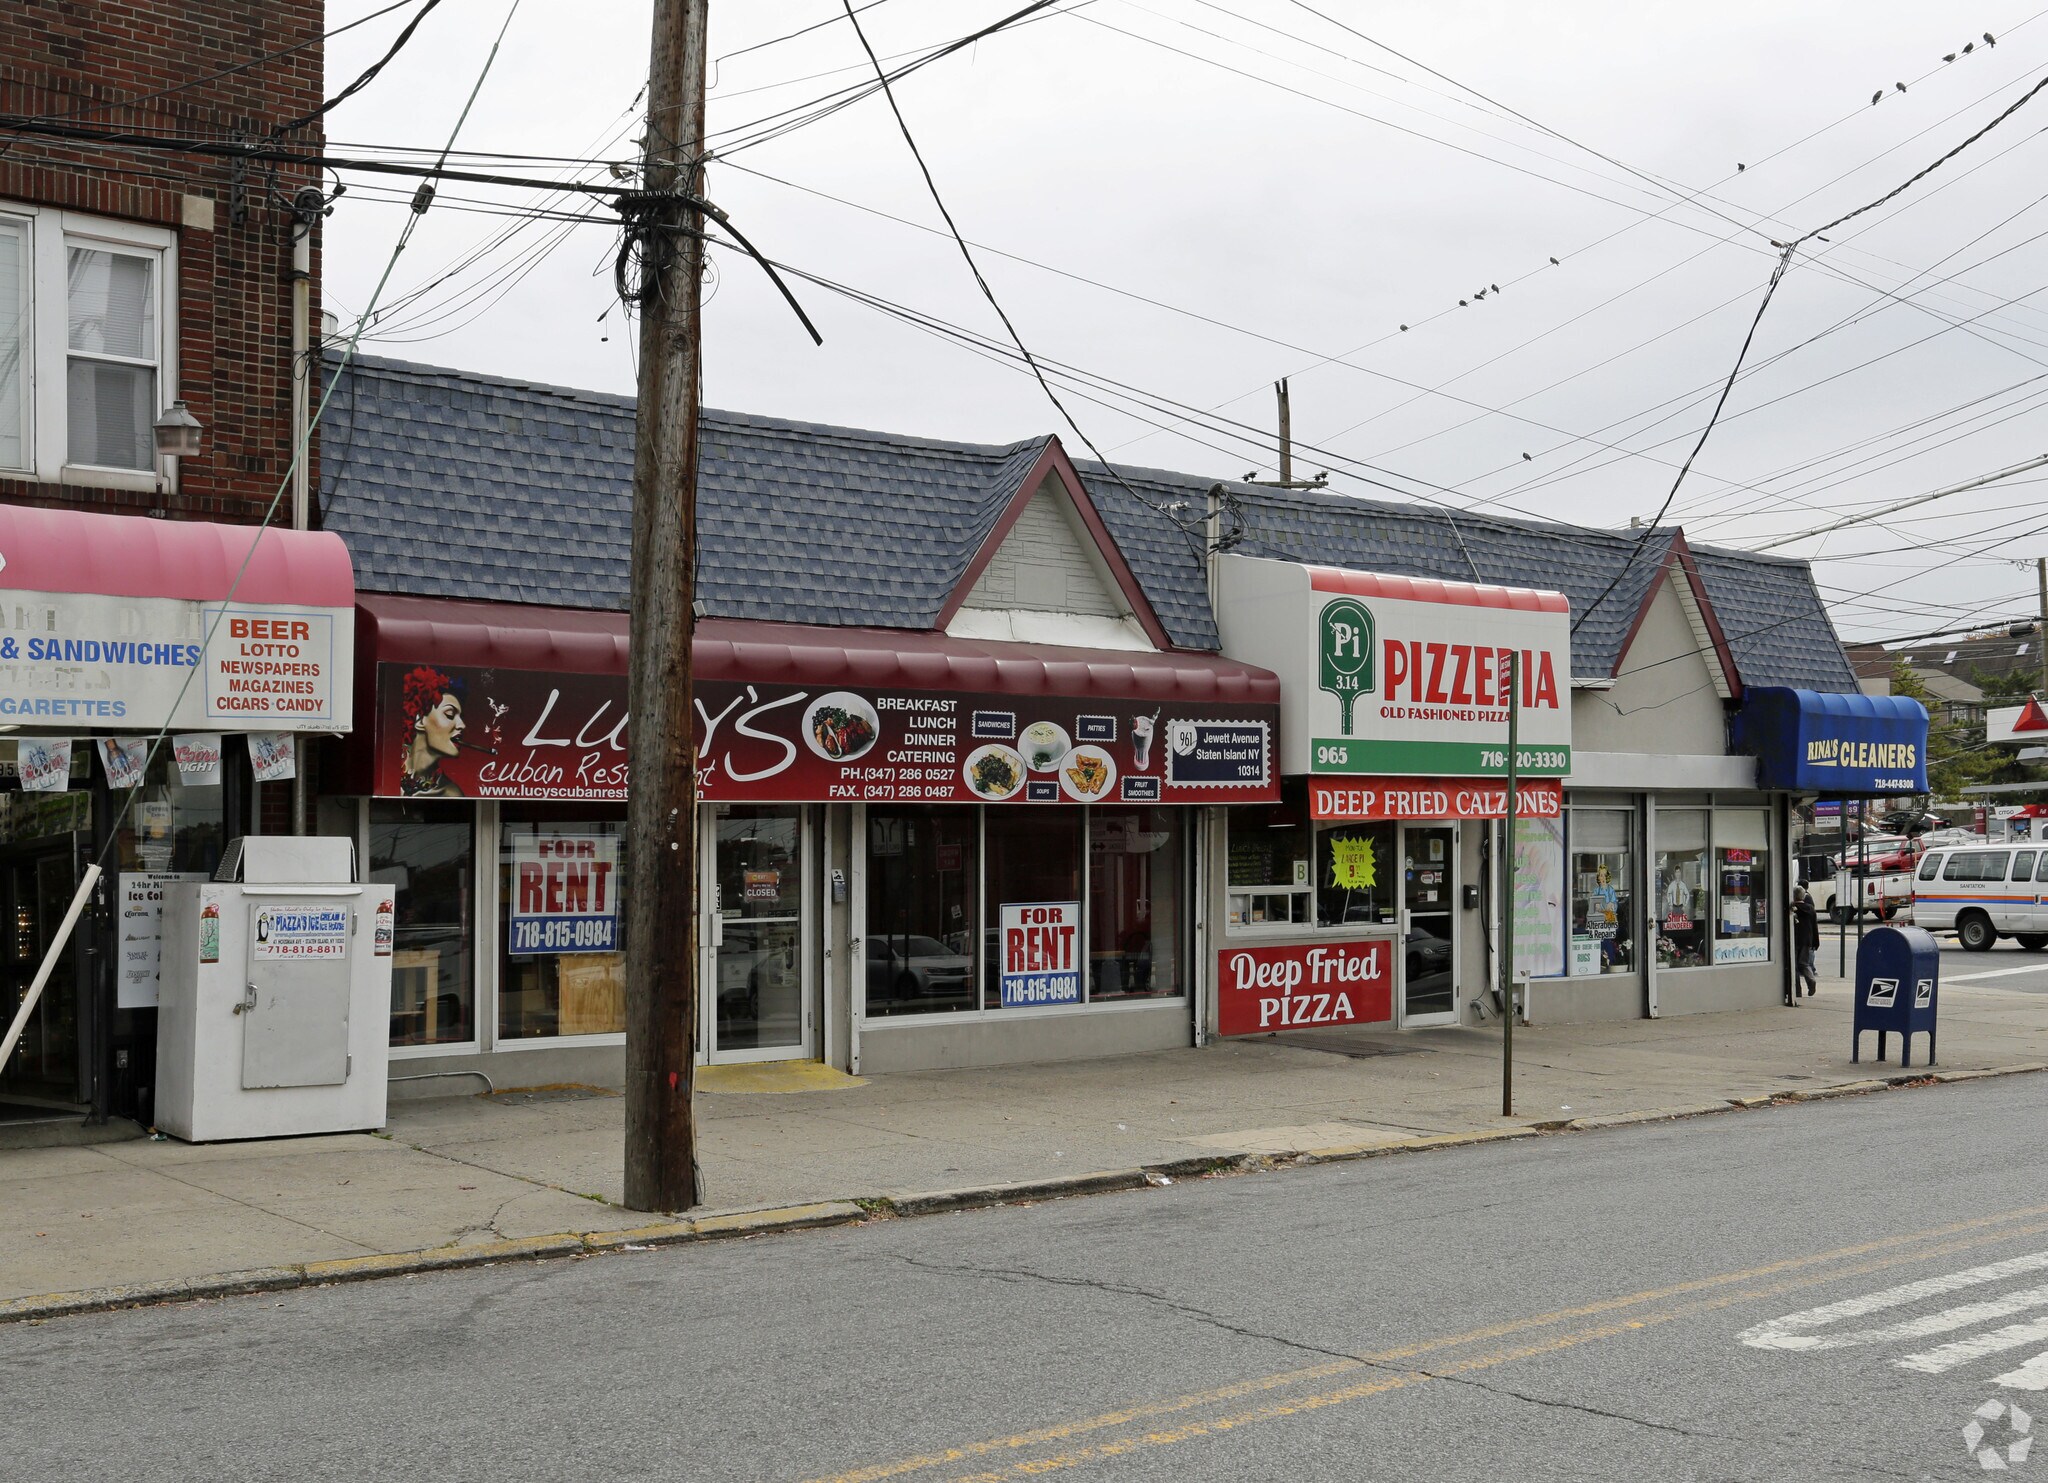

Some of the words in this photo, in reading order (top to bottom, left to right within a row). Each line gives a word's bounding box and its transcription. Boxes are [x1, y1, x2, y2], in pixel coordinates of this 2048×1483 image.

[230, 619, 310, 640] BEER
[1334, 622, 1360, 658] Pi
[1, 637, 20, 660] &
[28, 638, 201, 667] SANDWICHES
[240, 643, 300, 658] LOTTO
[220, 660, 320, 677] NEWSPAPERS
[229, 679, 314, 695] MAGAZINES
[1336, 675, 1359, 690] 3.14
[216, 696, 270, 711] CIGARS
[275, 699, 324, 712] CANDY
[877, 698, 958, 712] BREAKFAST
[1380, 706, 1406, 719] OLD
[1408, 708, 1476, 722] FASHIONED
[909, 716, 957, 729] LUNCH
[978, 720, 1011, 729] SANDWICHES
[1087, 724, 1106, 732] PATTIES
[522, 685, 809, 782] LUY'S
[904, 733, 956, 746] DINNER
[1180, 731, 1193, 747] 961
[1203, 732, 1230, 744] Jewett
[1231, 732, 1260, 744] Avenue
[887, 750, 956, 763] CATERING
[1196, 749, 1222, 760] Staten
[1223, 749, 1247, 760] Island
[1248, 749, 1260, 760] NY
[1317, 746, 1348, 765] 965
[1481, 751, 1566, 768] 718-20-3330
[1807, 739, 1839, 761] RINA'S
[1840, 741, 1916, 769] CLEANERS
[899, 768, 922, 780] 286
[925, 769, 955, 780] 0527
[1238, 765, 1260, 776] 10314
[829, 784, 860, 797] FAX.
[864, 784, 895, 799] (347)
[898, 785, 921, 797] 286
[925, 786, 955, 798] 0487
[1316, 790, 1376, 815] DEEP
[1383, 790, 1448, 815] FRIED
[538, 839, 596, 859] FOR
[1297, 864, 1305, 880] B
[518, 861, 612, 914] RENT
[746, 888, 777, 897] CLOSED
[128, 891, 144, 901] Ice
[276, 915, 307, 931] PIAZZA'S
[1020, 907, 1063, 925] FOR
[1667, 911, 1688, 923] Shirts
[1586, 920, 1619, 930] Alterations
[1663, 922, 1693, 930] LAUNDERED
[515, 920, 613, 949] 718-815-0984
[1594, 930, 1616, 939] Repairs
[268, 945, 343, 954] 718-818-8811
[1006, 926, 1076, 973] RENT
[1230, 952, 1303, 996] Deep
[1306, 947, 1381, 985] Fried
[1005, 976, 1077, 1003] 718-815-0984
[1259, 992, 1355, 1028] PIZZA
